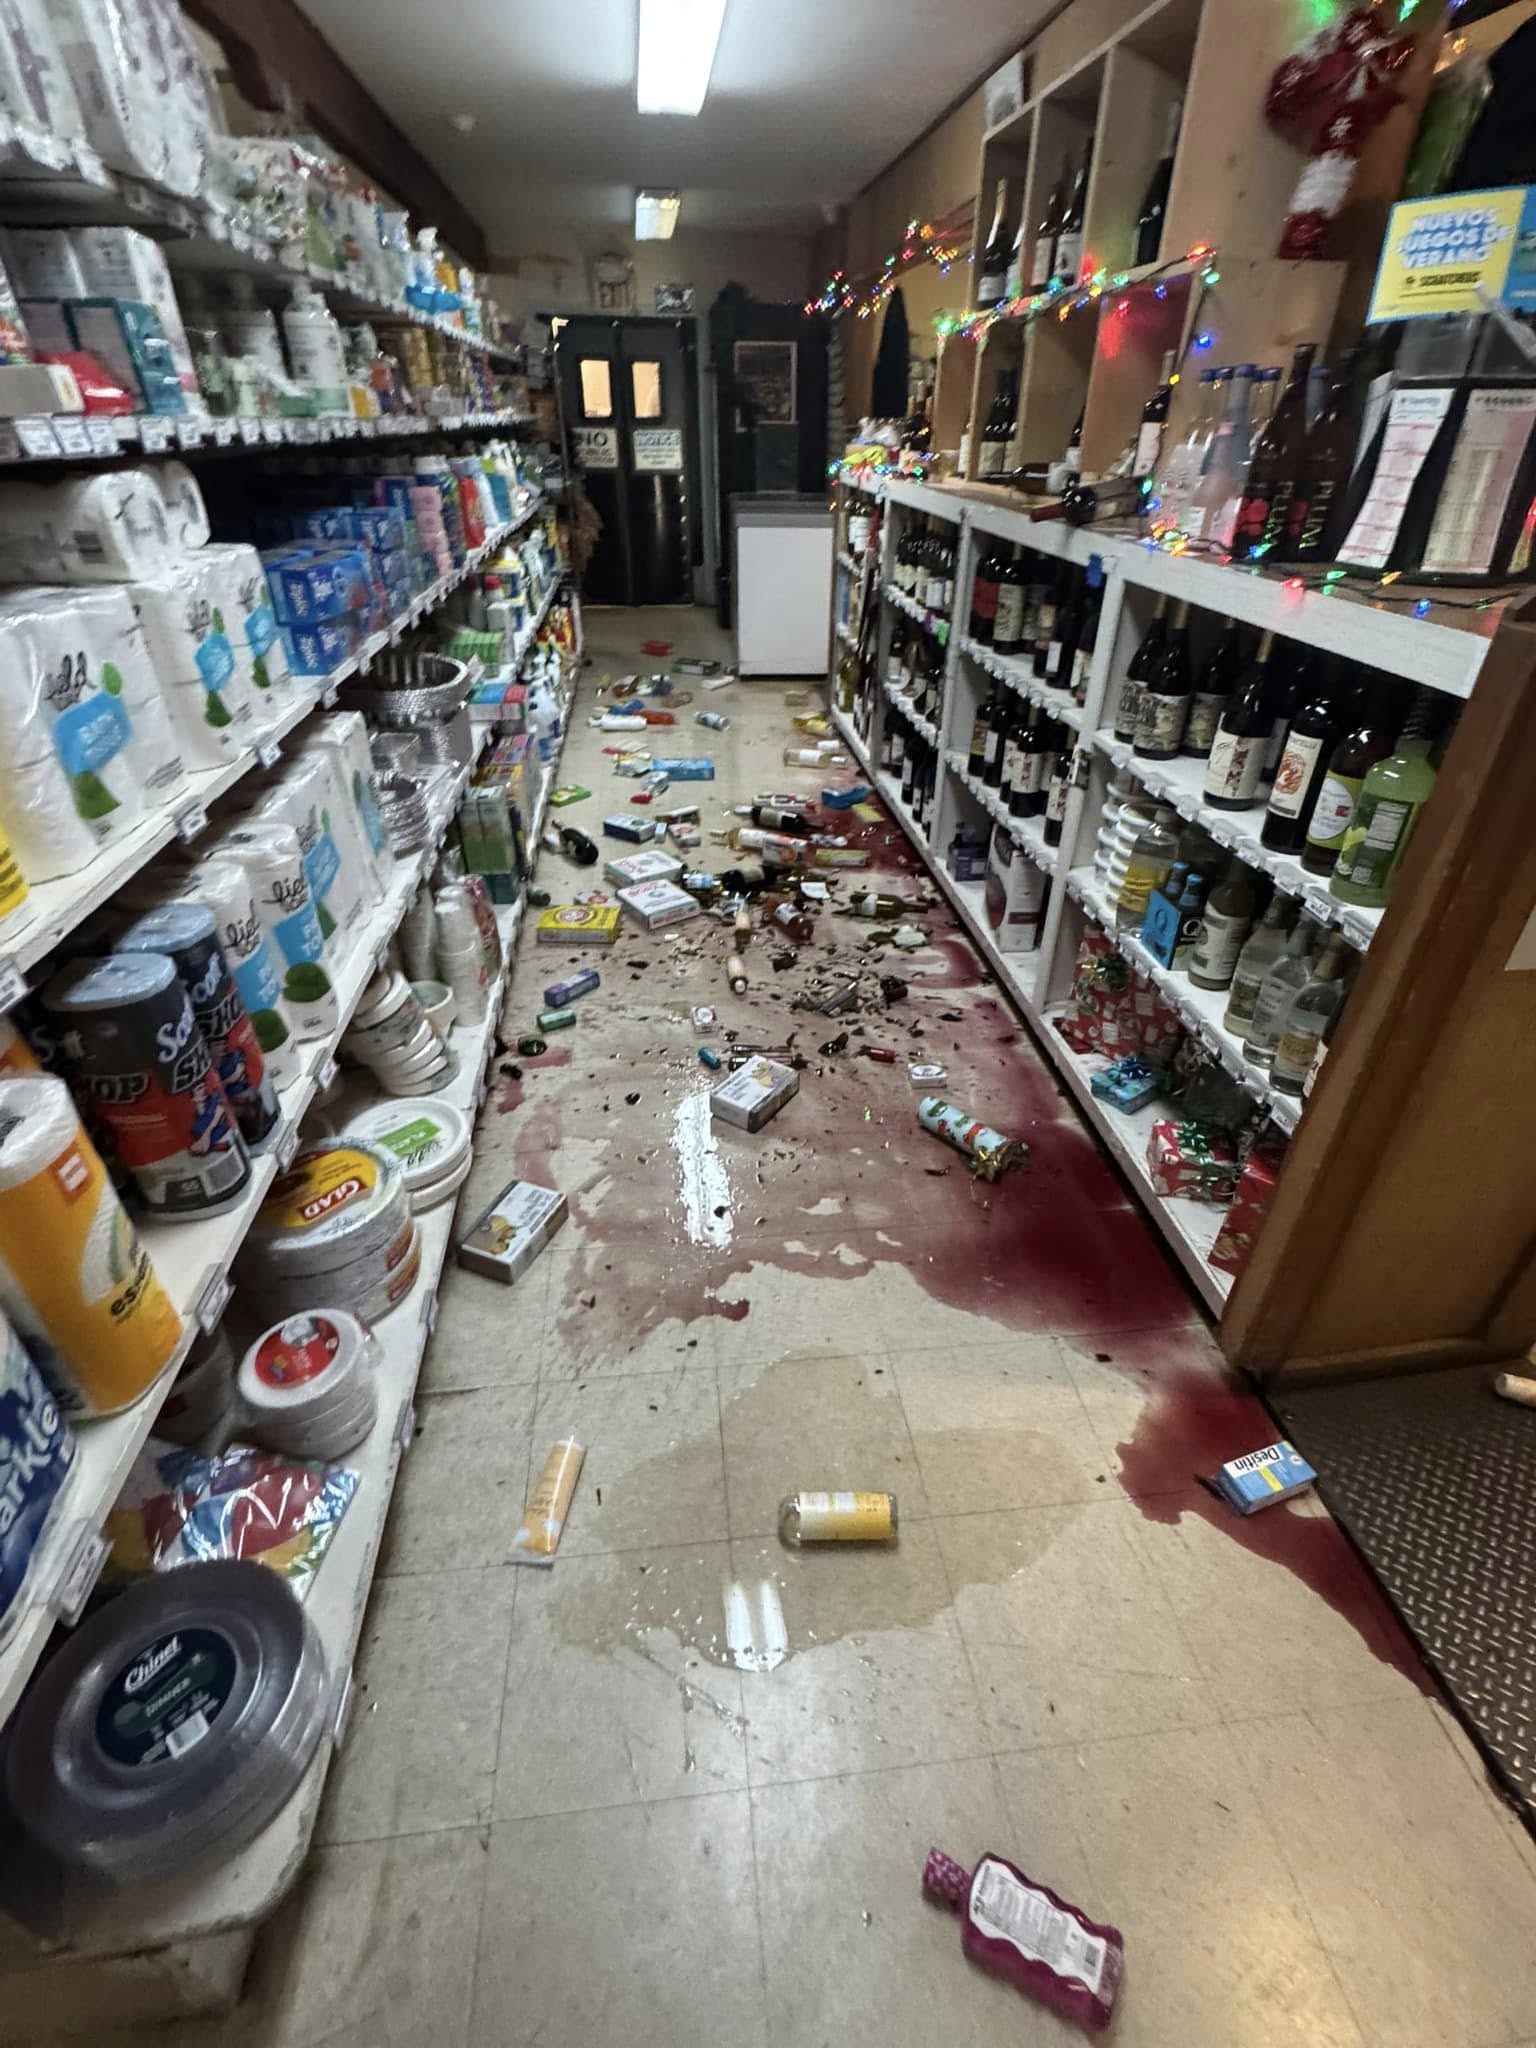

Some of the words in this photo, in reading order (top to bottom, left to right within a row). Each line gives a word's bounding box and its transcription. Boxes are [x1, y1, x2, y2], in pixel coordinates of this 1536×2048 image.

[1413, 208, 1499, 232] NUEVOS
[303, 1178, 361, 1219] GLAD
[1234, 1447, 1280, 1473] Desitin
[124, 1635, 182, 1694] Chinet
